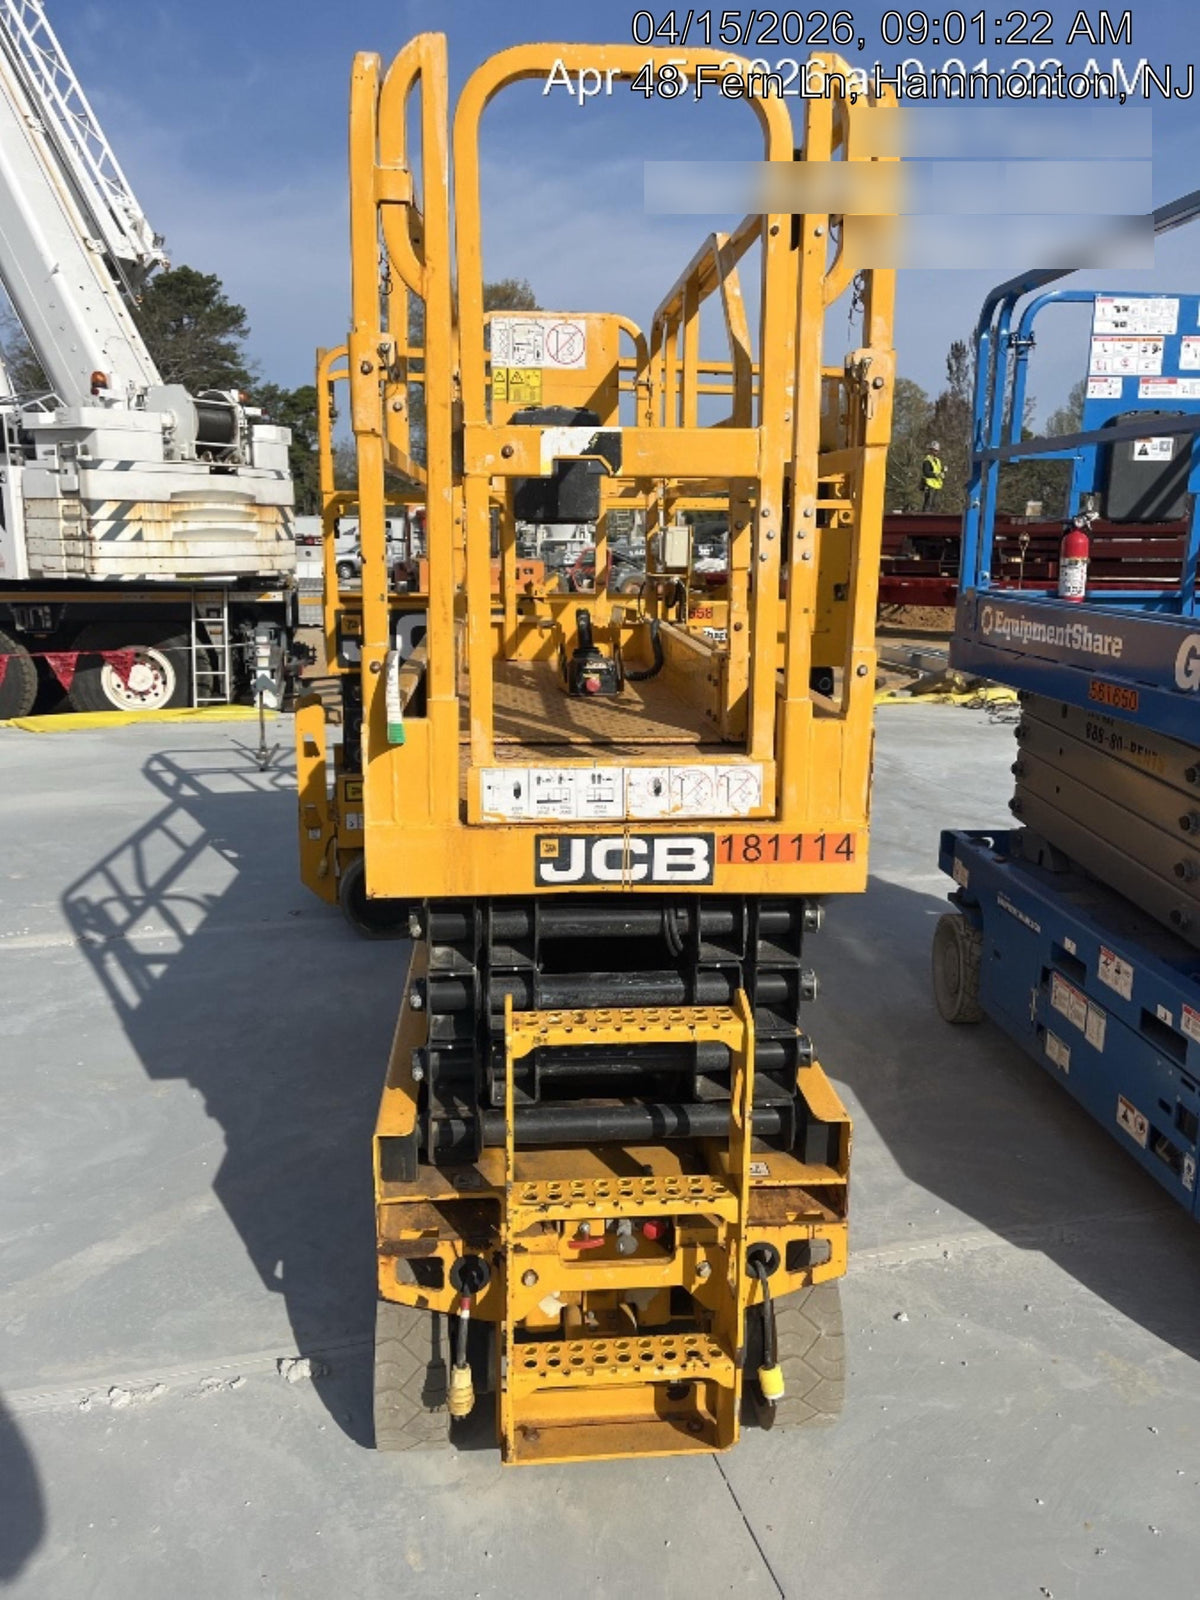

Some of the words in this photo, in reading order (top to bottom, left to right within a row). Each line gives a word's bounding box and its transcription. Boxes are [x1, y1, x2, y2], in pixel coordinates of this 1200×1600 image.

[995, 610, 1124, 658] EquipmentShare
[540, 838, 710, 882] JCB
[721, 833, 854, 863] 181114
